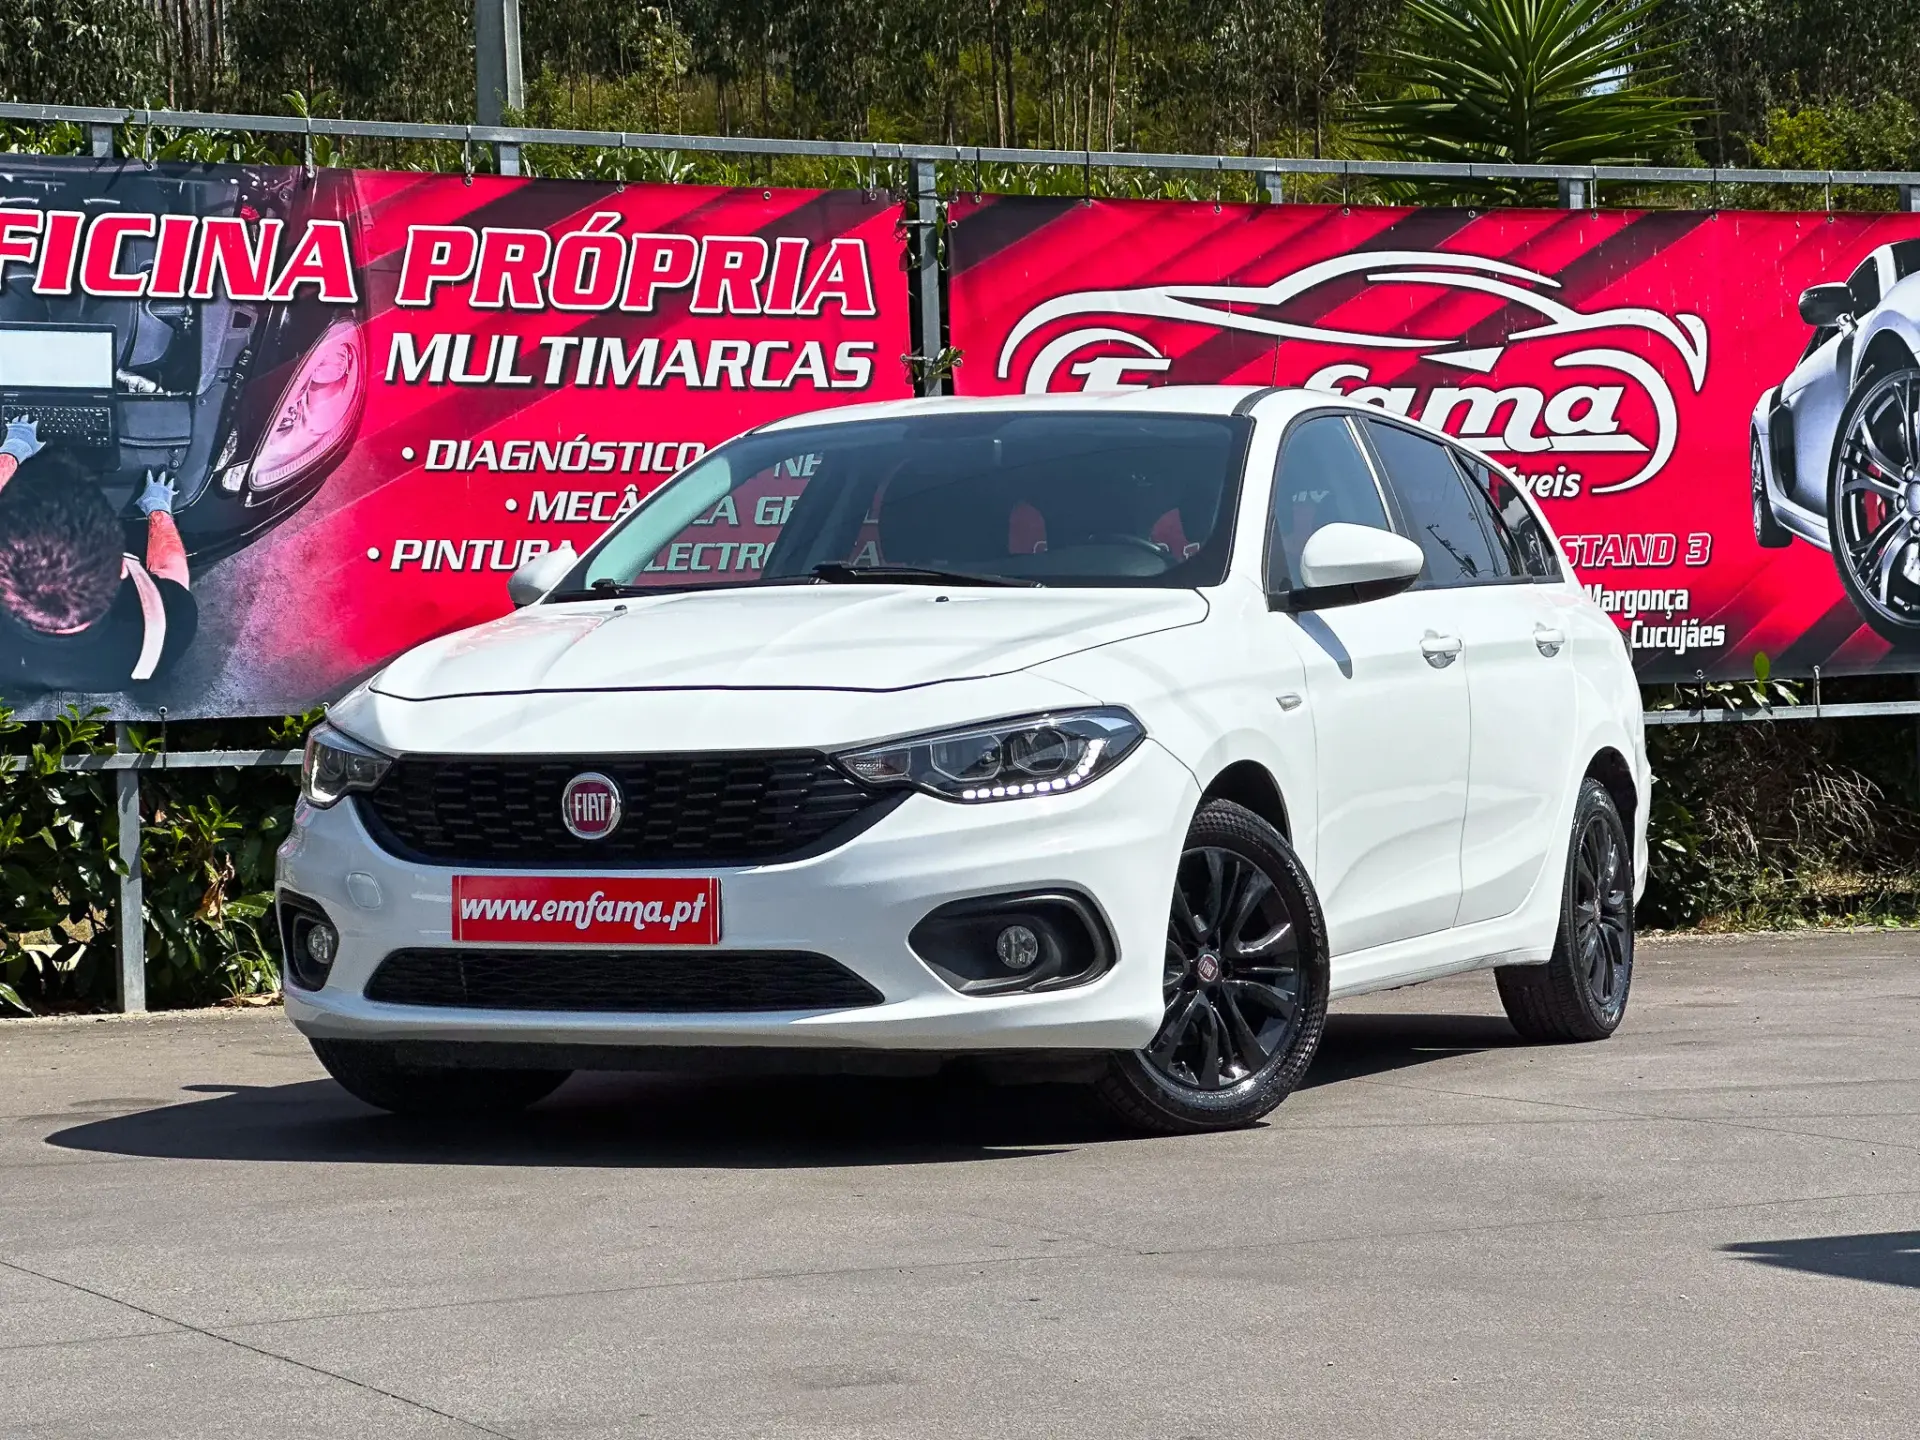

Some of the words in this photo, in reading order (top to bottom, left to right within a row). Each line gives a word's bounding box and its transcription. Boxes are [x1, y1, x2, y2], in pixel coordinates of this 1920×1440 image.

[394, 212, 876, 315] PRÓPRIA
[385, 333, 874, 388] MULTIMARCAS
[425, 434, 706, 472] DIAGNÓSTICO
[1558, 533, 1677, 567] STAND
[1685, 532, 1712, 565] 3
[1583, 583, 1689, 619] Margonça
[1631, 618, 1726, 654] Cucujães
[574, 792, 609, 822] FIAT
[460, 891, 706, 931] www.emfama.pt
